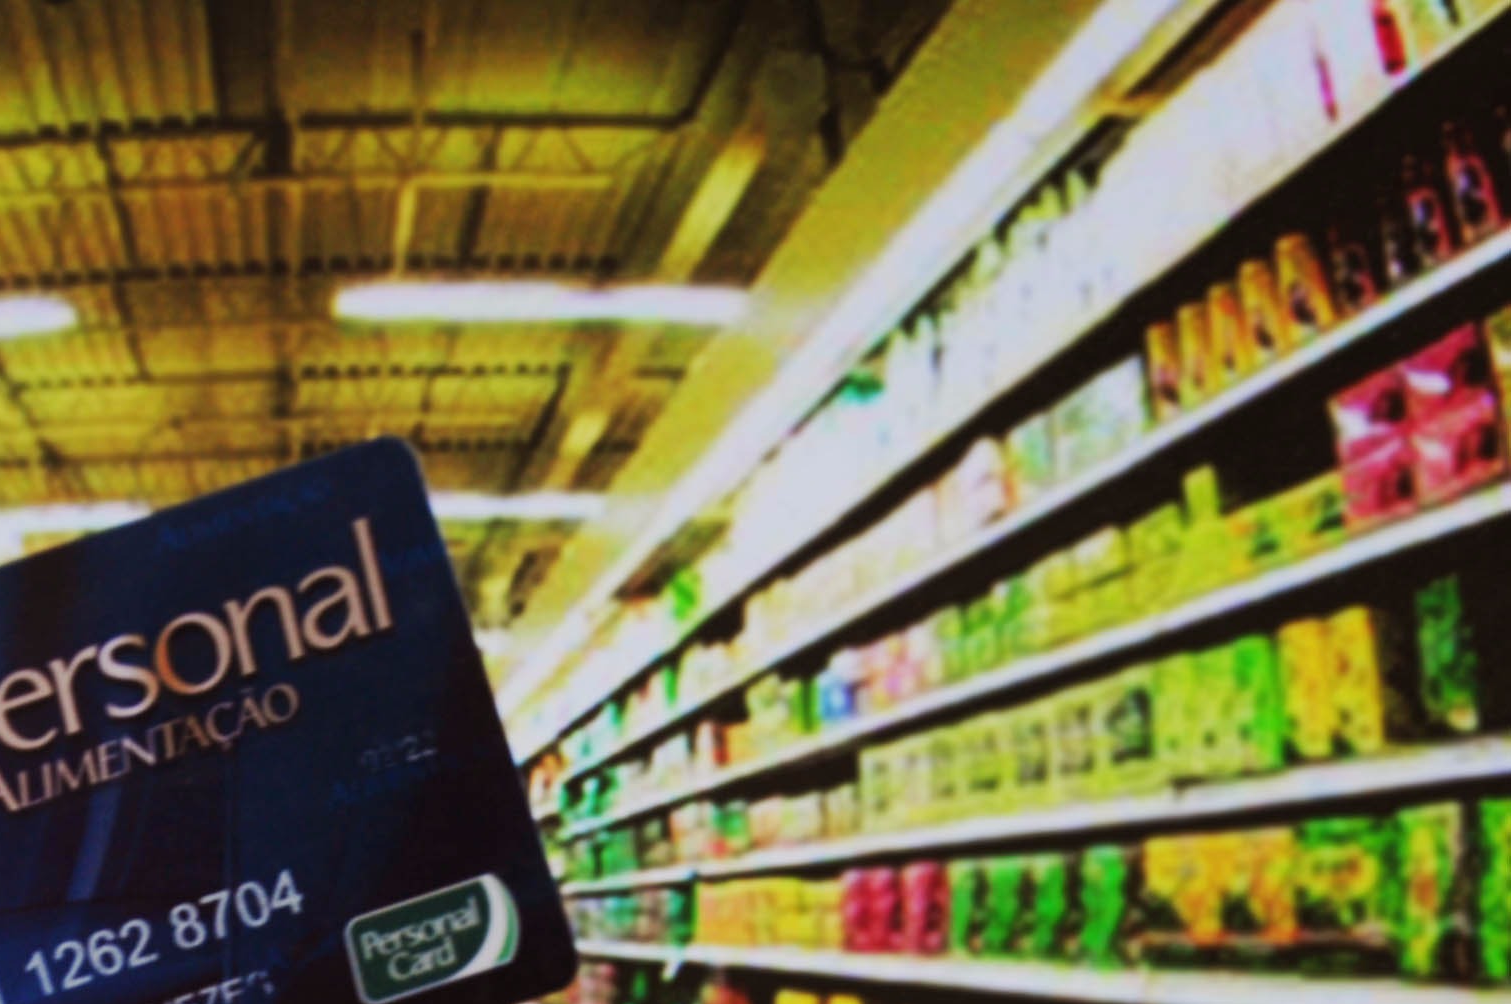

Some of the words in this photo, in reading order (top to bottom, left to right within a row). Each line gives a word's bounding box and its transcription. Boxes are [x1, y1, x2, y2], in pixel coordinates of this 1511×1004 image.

[25, 917, 160, 997] 1262
[168, 868, 304, 950] 8704
[359, 895, 483, 962] Personal
[387, 935, 457, 982] Card
